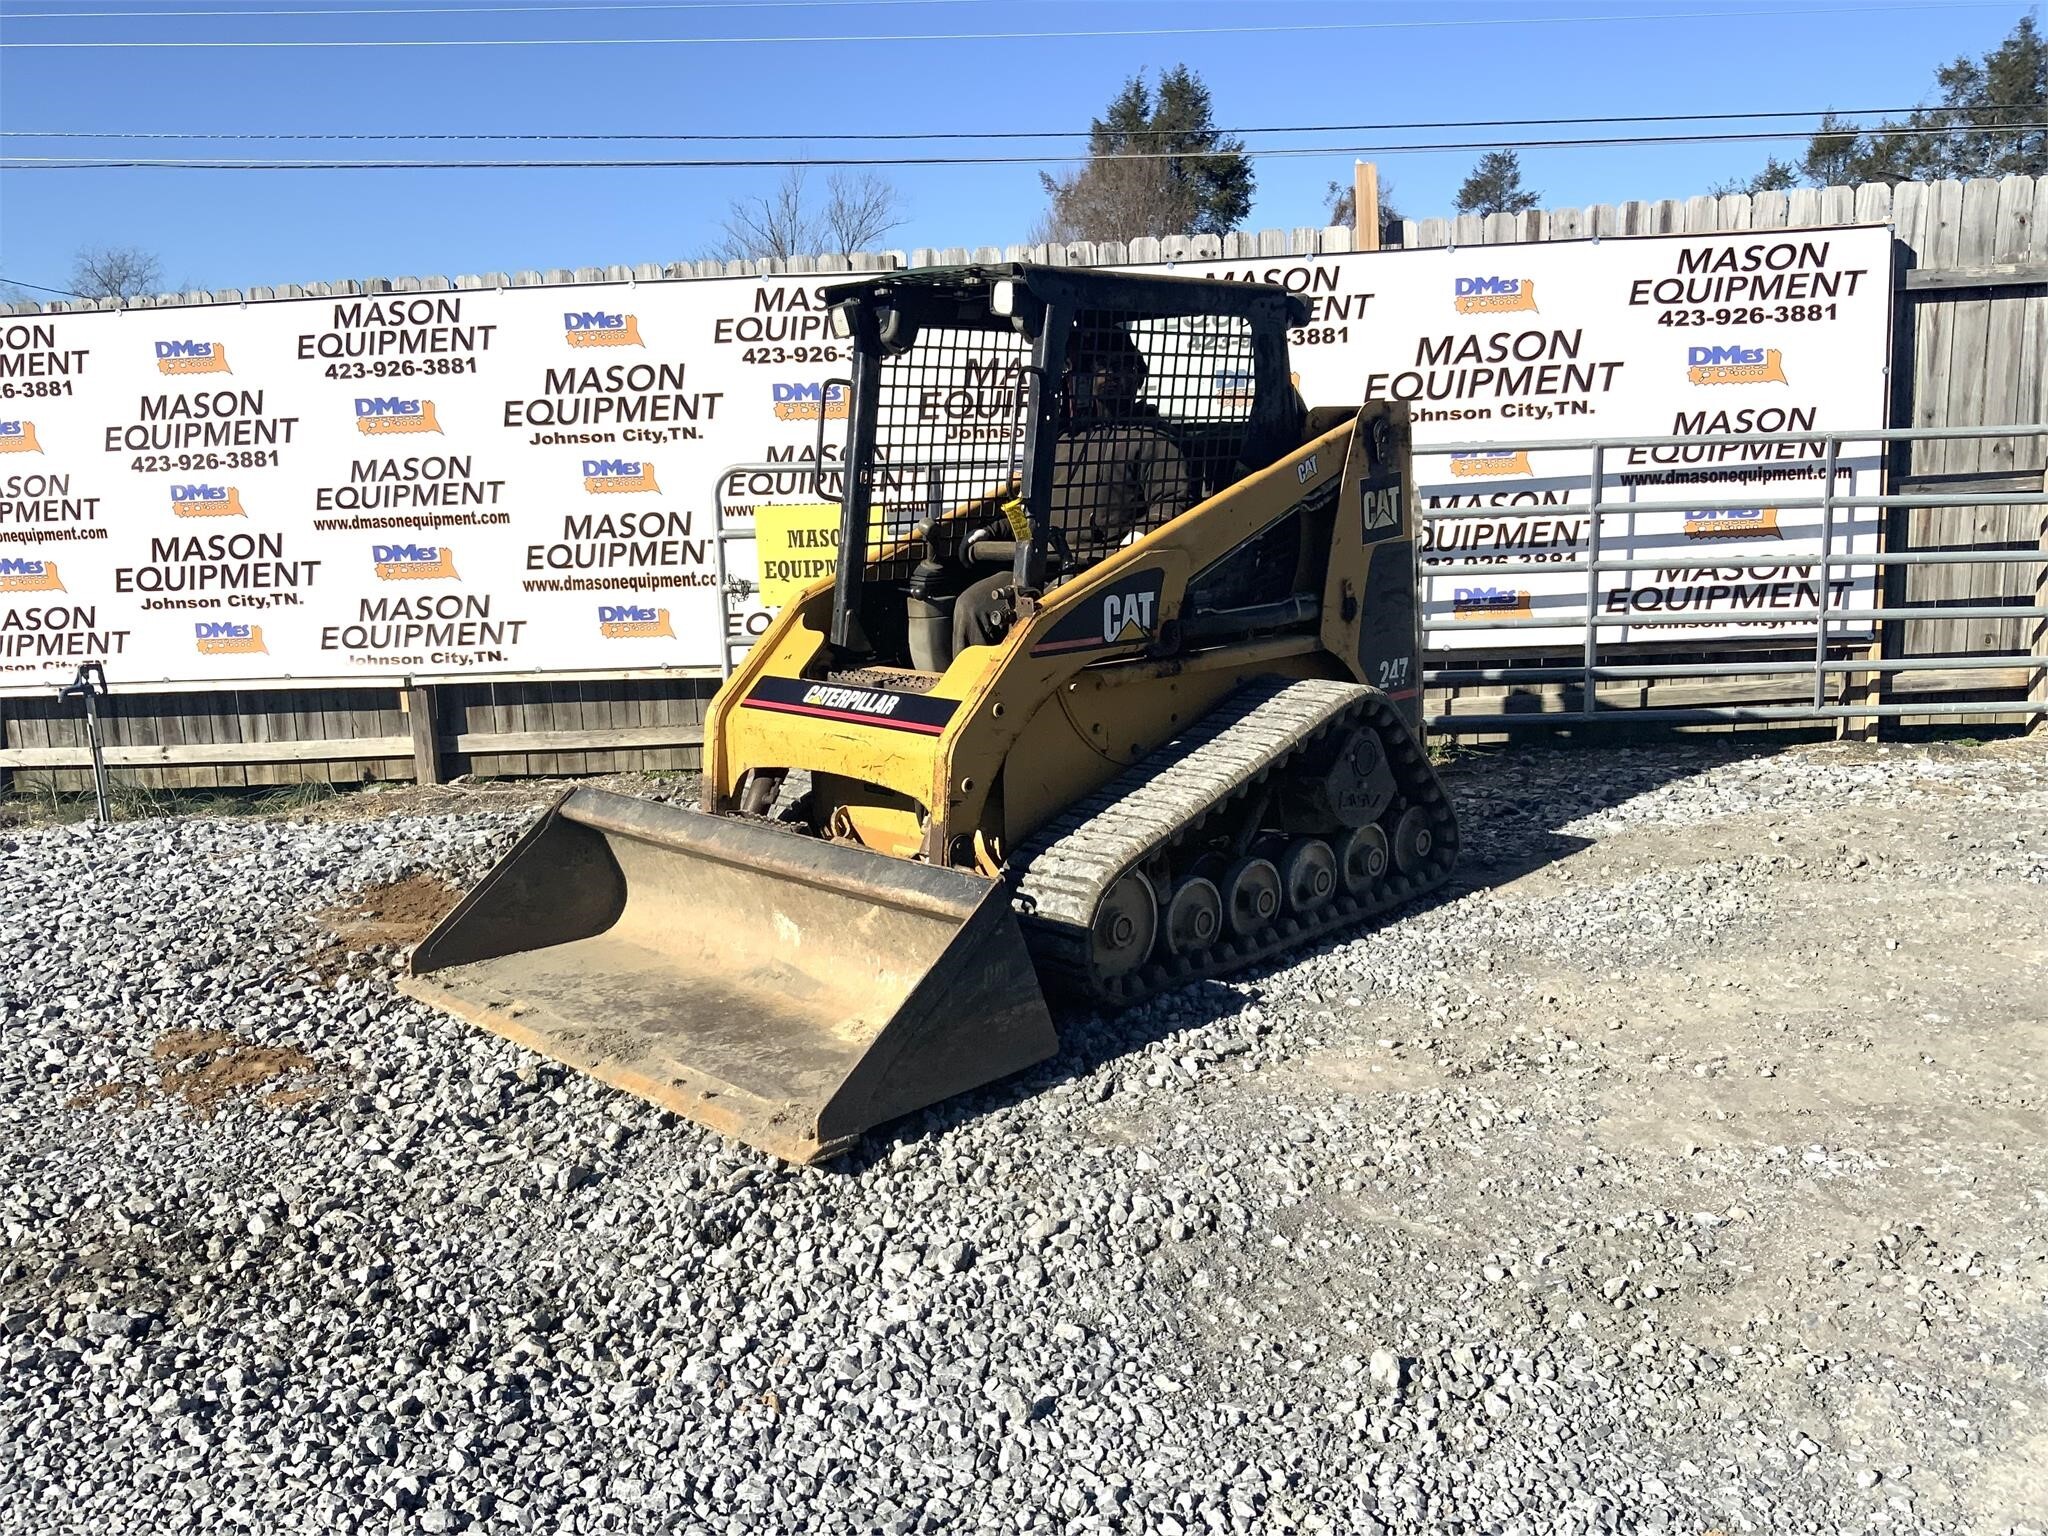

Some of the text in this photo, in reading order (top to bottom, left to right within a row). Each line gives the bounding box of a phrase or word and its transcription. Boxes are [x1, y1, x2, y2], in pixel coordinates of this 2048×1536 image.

[1677, 242, 1829, 274] MASON
[754, 286, 828, 313] MAS
[1629, 270, 1868, 305] EQUIPMENT
[334, 298, 460, 329] MASON
[1658, 303, 1836, 327] 423-926-3881
[0, 324, 54, 350] ON
[298, 325, 497, 359] EQUIPMENT
[714, 315, 836, 344] EQUIP
[1415, 329, 1582, 366] MASON
[325, 357, 476, 379] 423-926-3881
[545, 363, 685, 395] MASON
[1364, 362, 1624, 403] EQUIPMENT
[0, 380, 72, 398] 6-3881
[141, 390, 263, 421] MASON
[504, 393, 724, 428] EQUIPMENT
[920, 391, 1029, 420] EQUIP
[1411, 404, 1492, 422] ohnson
[105, 418, 299, 452] EQUIPMENT
[948, 425, 1025, 440] Johnso
[1672, 407, 1816, 436] MASON
[529, 432, 615, 445] Johnson
[1628, 441, 1843, 465] EQUIPMEN
[131, 450, 278, 472] 423-926-3881
[351, 456, 471, 483] MASON
[1297, 454, 1319, 485] CAT
[1620, 464, 1852, 487] www.dmasonequipment.cm
[0, 474, 69, 498] SON
[317, 481, 505, 510] EQUIPMENT
[313, 511, 510, 530] www.dmasonequipment.com
[1364, 486, 1400, 530] CAT
[564, 511, 691, 540] MASON
[787, 529, 840, 548] MASO
[152, 533, 282, 563] MASON
[116, 561, 321, 592] EQUIPMENT
[523, 571, 716, 593] www.dmasonequipment.co
[764, 560, 838, 582] EQUIPM
[141, 598, 221, 610] Johnson
[360, 595, 490, 622] MASON
[1606, 581, 1854, 613] EQUIPMENT
[1103, 591, 1155, 643] CAT
[0, 631, 130, 657] IPMENT
[321, 621, 527, 650] EQUIPMENT
[1379, 657, 1409, 689] 247
[803, 685, 900, 715] CATERPILLAR
